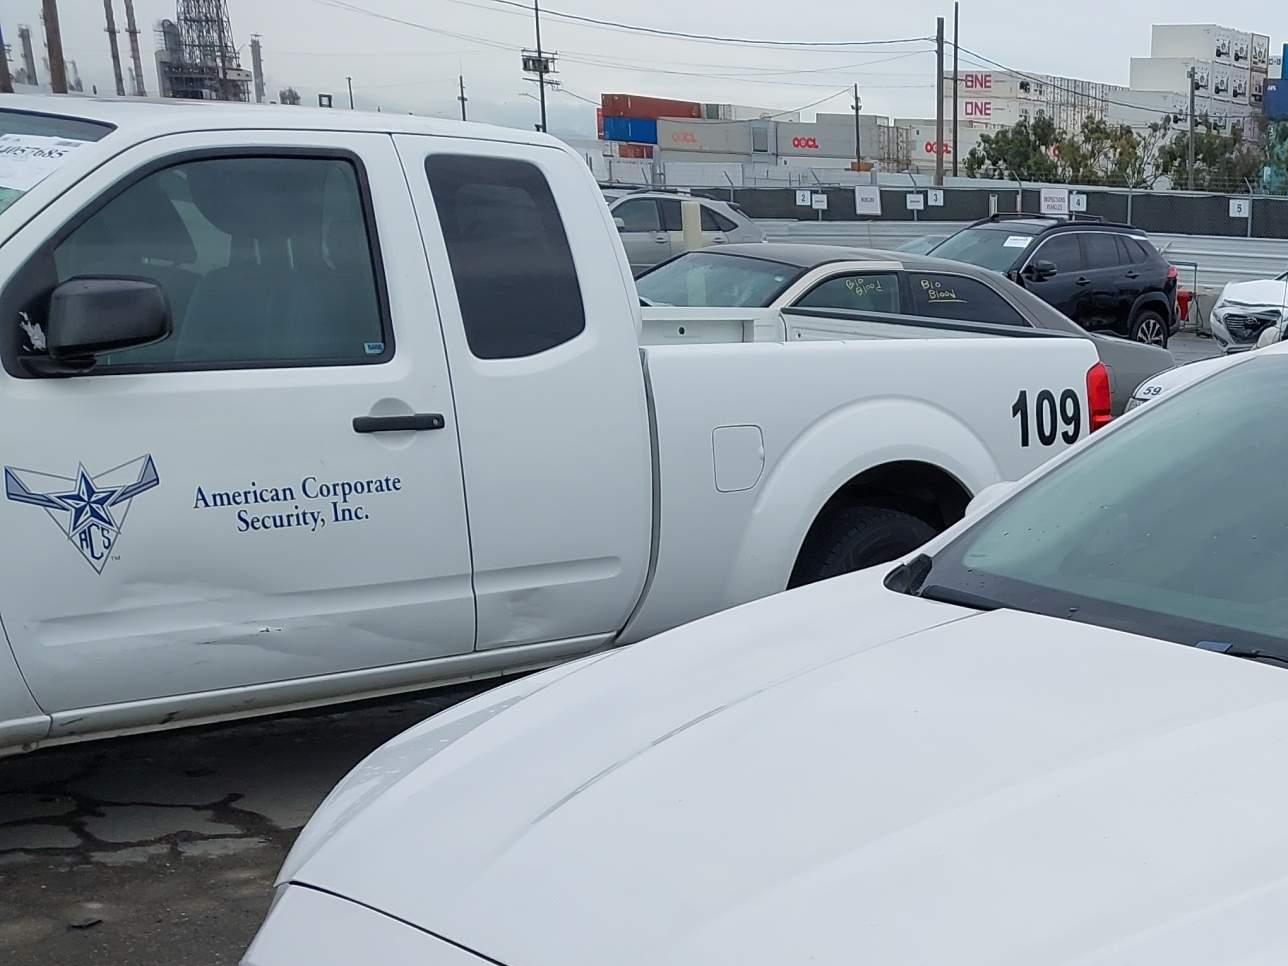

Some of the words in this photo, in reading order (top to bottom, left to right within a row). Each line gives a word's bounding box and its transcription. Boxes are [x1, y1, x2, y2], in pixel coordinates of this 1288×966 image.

[964, 74, 992, 88] ONE
[964, 102, 992, 116] ONE
[792, 136, 819, 149] OOCL
[801, 194, 806, 202] 2
[933, 193, 938, 202] 3
[1075, 198, 1081, 207] 4
[1236, 204, 1242, 213] 5
[1142, 386, 1162, 396] 59
[1011, 388, 1081, 448] 109
[193, 481, 295, 510] American
[301, 474, 402, 503] Corporate
[236, 504, 326, 533] Security,
[332, 501, 370, 524] Inc.
[79, 523, 112, 561] ACS
